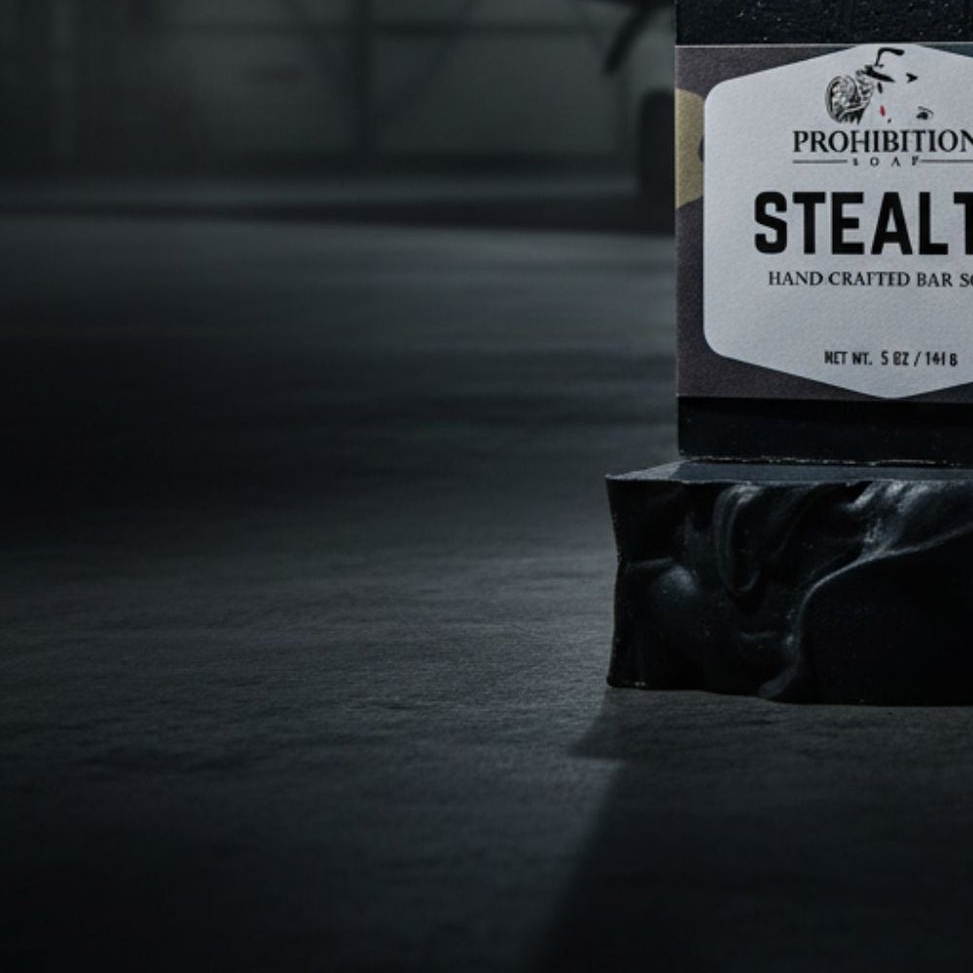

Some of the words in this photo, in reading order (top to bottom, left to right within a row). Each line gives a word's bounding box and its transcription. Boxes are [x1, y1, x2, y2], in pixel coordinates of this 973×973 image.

[768, 271, 824, 286] HAND
[827, 271, 911, 287] CRAFTED
[916, 272, 954, 288] BAR
